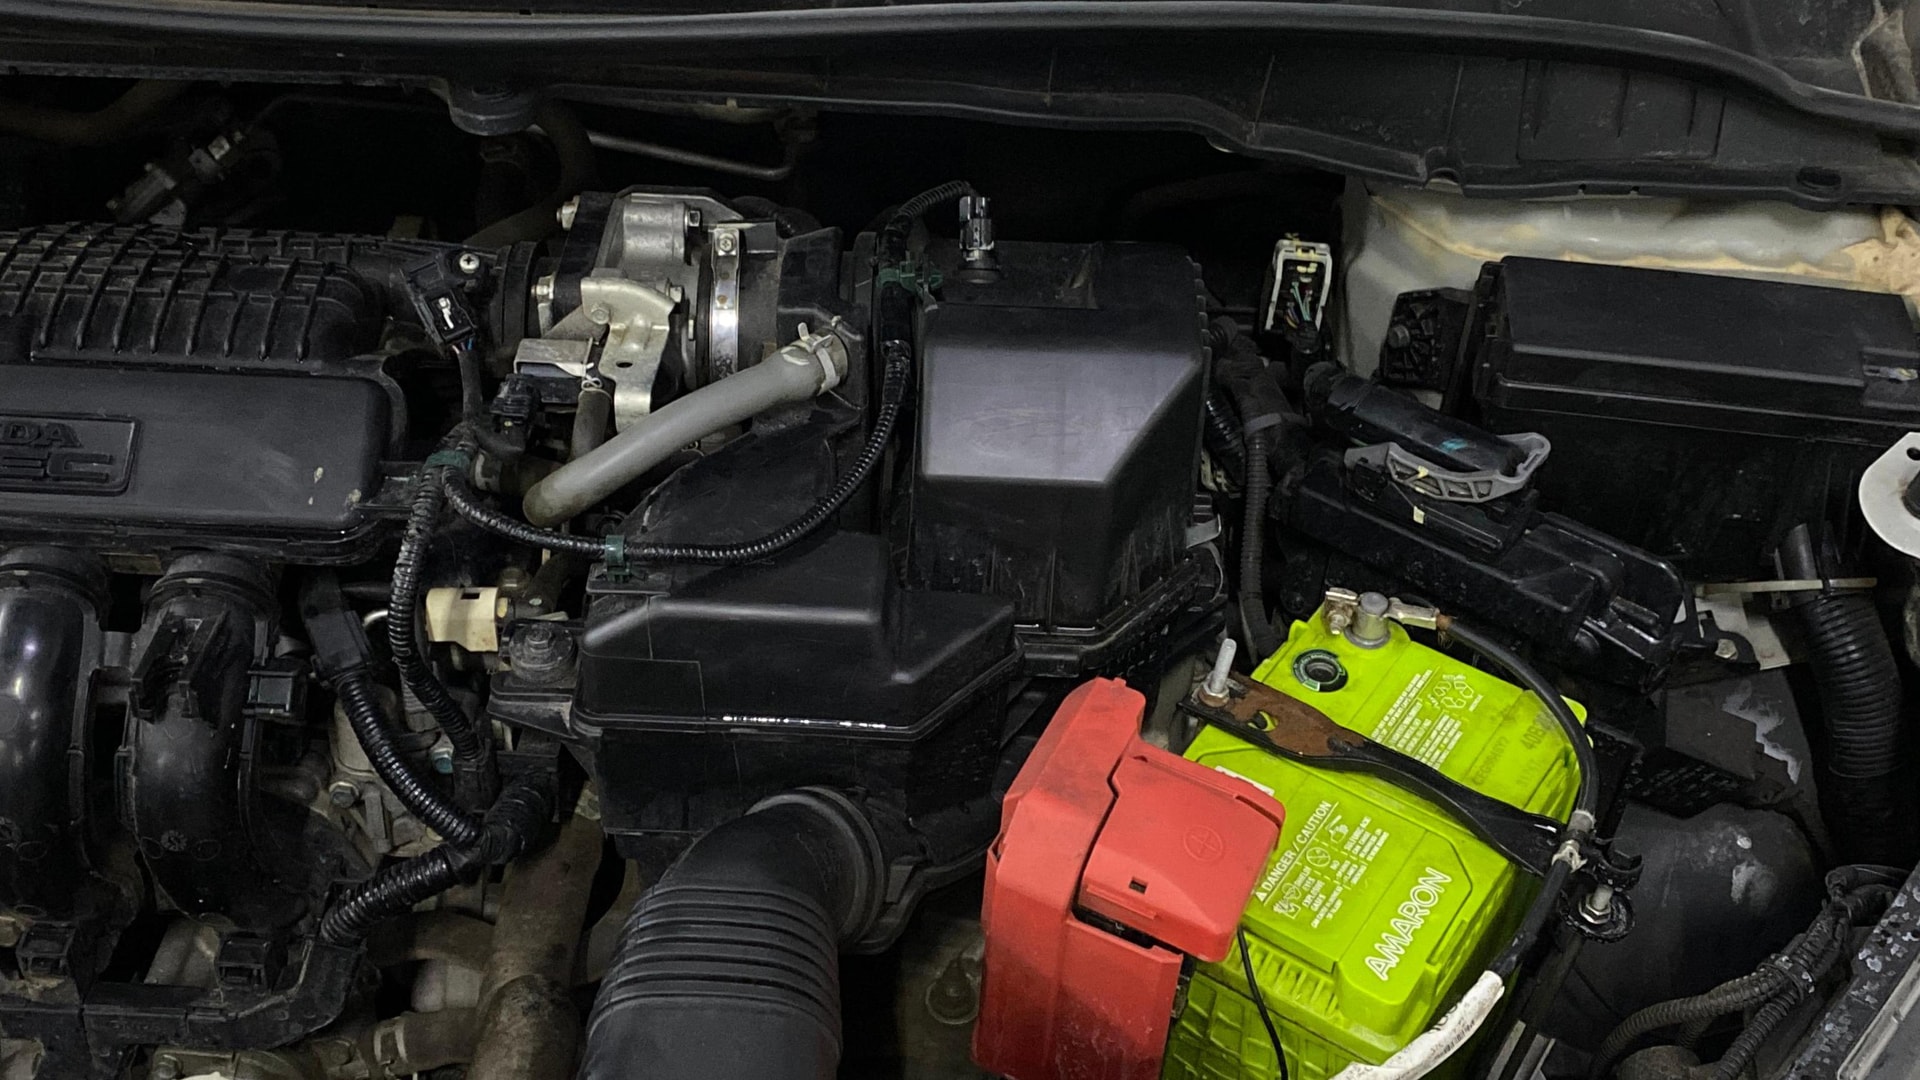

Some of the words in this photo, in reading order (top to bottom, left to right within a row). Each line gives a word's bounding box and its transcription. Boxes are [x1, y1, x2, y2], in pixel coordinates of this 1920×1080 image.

[0, 421, 82, 447] DA
[1261, 850, 1296, 891] DANGER
[1296, 801, 1332, 843] CAUTION
[1365, 867, 1451, 981] AMARON
